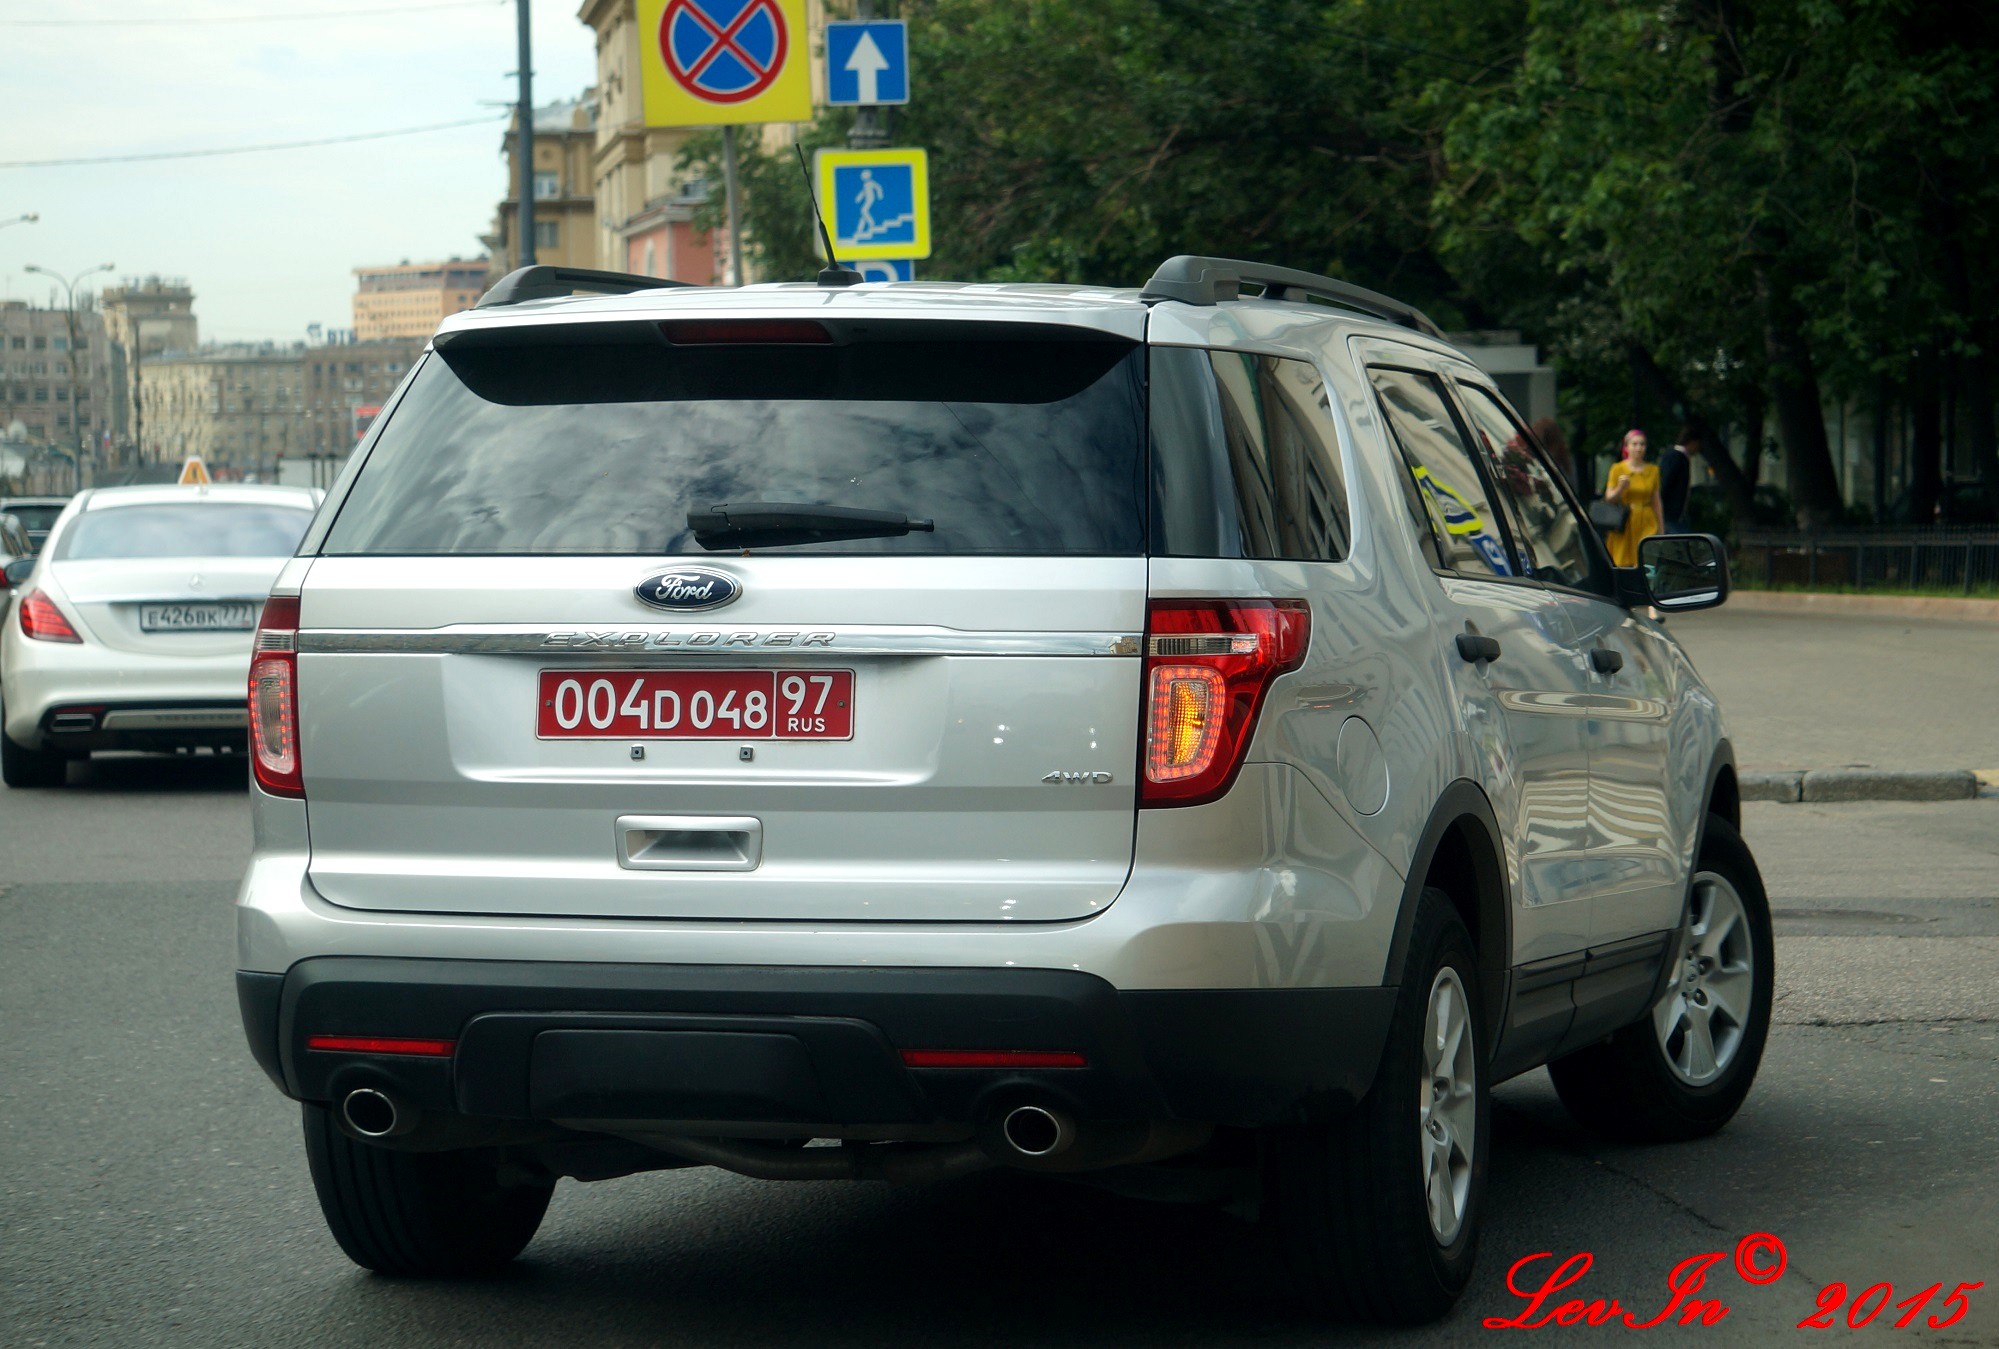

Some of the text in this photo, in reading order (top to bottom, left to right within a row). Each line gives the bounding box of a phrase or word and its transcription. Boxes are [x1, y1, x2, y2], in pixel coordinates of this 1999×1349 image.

[655, 574, 714, 600] Ford
[541, 631, 836, 648] EXPLORER
[781, 675, 833, 715] 97
[787, 717, 826, 732] RUS
[1041, 770, 1114, 785] 4WD
